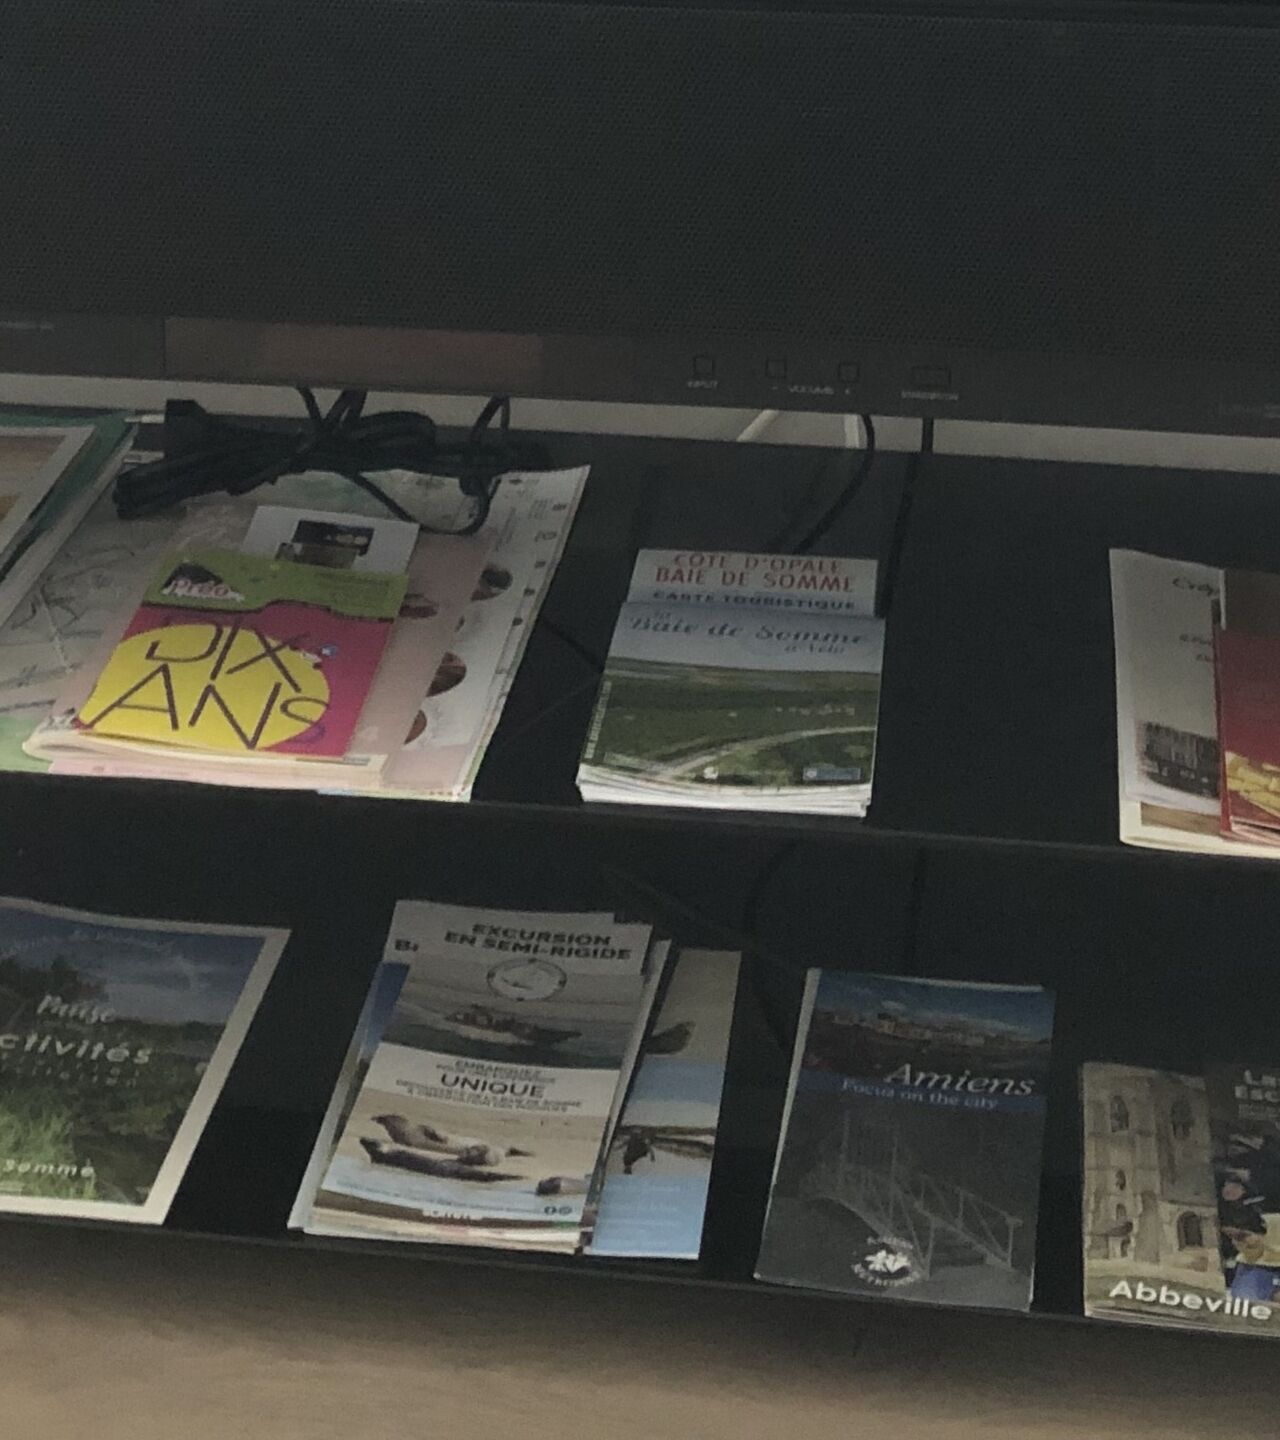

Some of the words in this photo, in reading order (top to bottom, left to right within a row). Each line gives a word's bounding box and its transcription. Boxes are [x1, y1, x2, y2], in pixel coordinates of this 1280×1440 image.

[655, 567, 706, 586] BAIE
[721, 570, 747, 587] DE
[763, 572, 855, 594] SOMME
[652, 590, 714, 604] CARTE
[723, 594, 856, 611] TOURISTIQUE
[707, 622, 742, 637] de
[84, 662, 331, 751] ANS
[444, 930, 477, 947] EN
[482, 937, 632, 961] SEMI-RIGIDE
[472, 923, 613, 947] EXCURSION
[441, 1073, 546, 1099] UNIQUE
[883, 1063, 1036, 1096] Amiens
[842, 1078, 895, 1098] Focus
[899, 1091, 924, 1103] on
[929, 1091, 960, 1105] the
[963, 1096, 999, 1111] city
[1108, 1279, 1274, 1321] Abbeville
